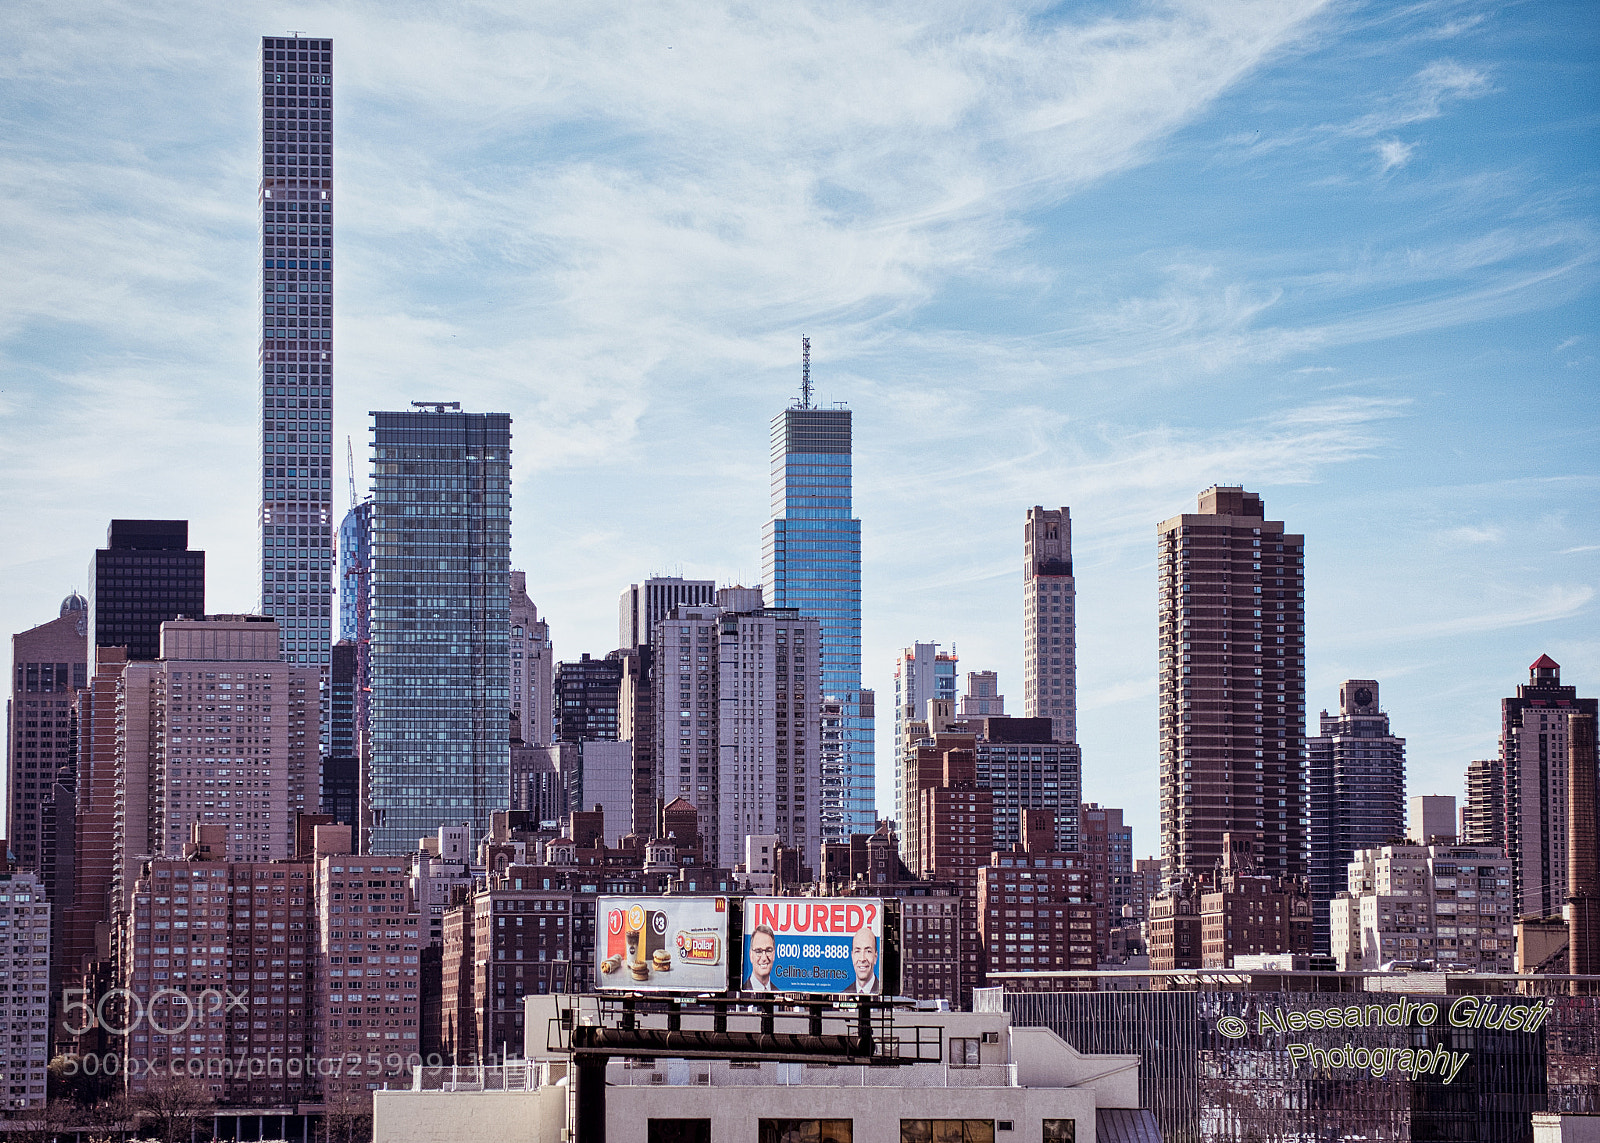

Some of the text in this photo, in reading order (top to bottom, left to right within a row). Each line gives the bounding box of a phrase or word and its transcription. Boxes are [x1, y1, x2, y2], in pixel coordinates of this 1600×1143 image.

[631, 911, 640, 924] $2
[655, 917, 665, 930] $3
[754, 903, 877, 933] INJURED?
[692, 940, 713, 950] Dollar
[776, 943, 850, 959] (800) 888-8888
[775, 964, 807, 978] Cellino
[813, 965, 848, 979] Barnes
